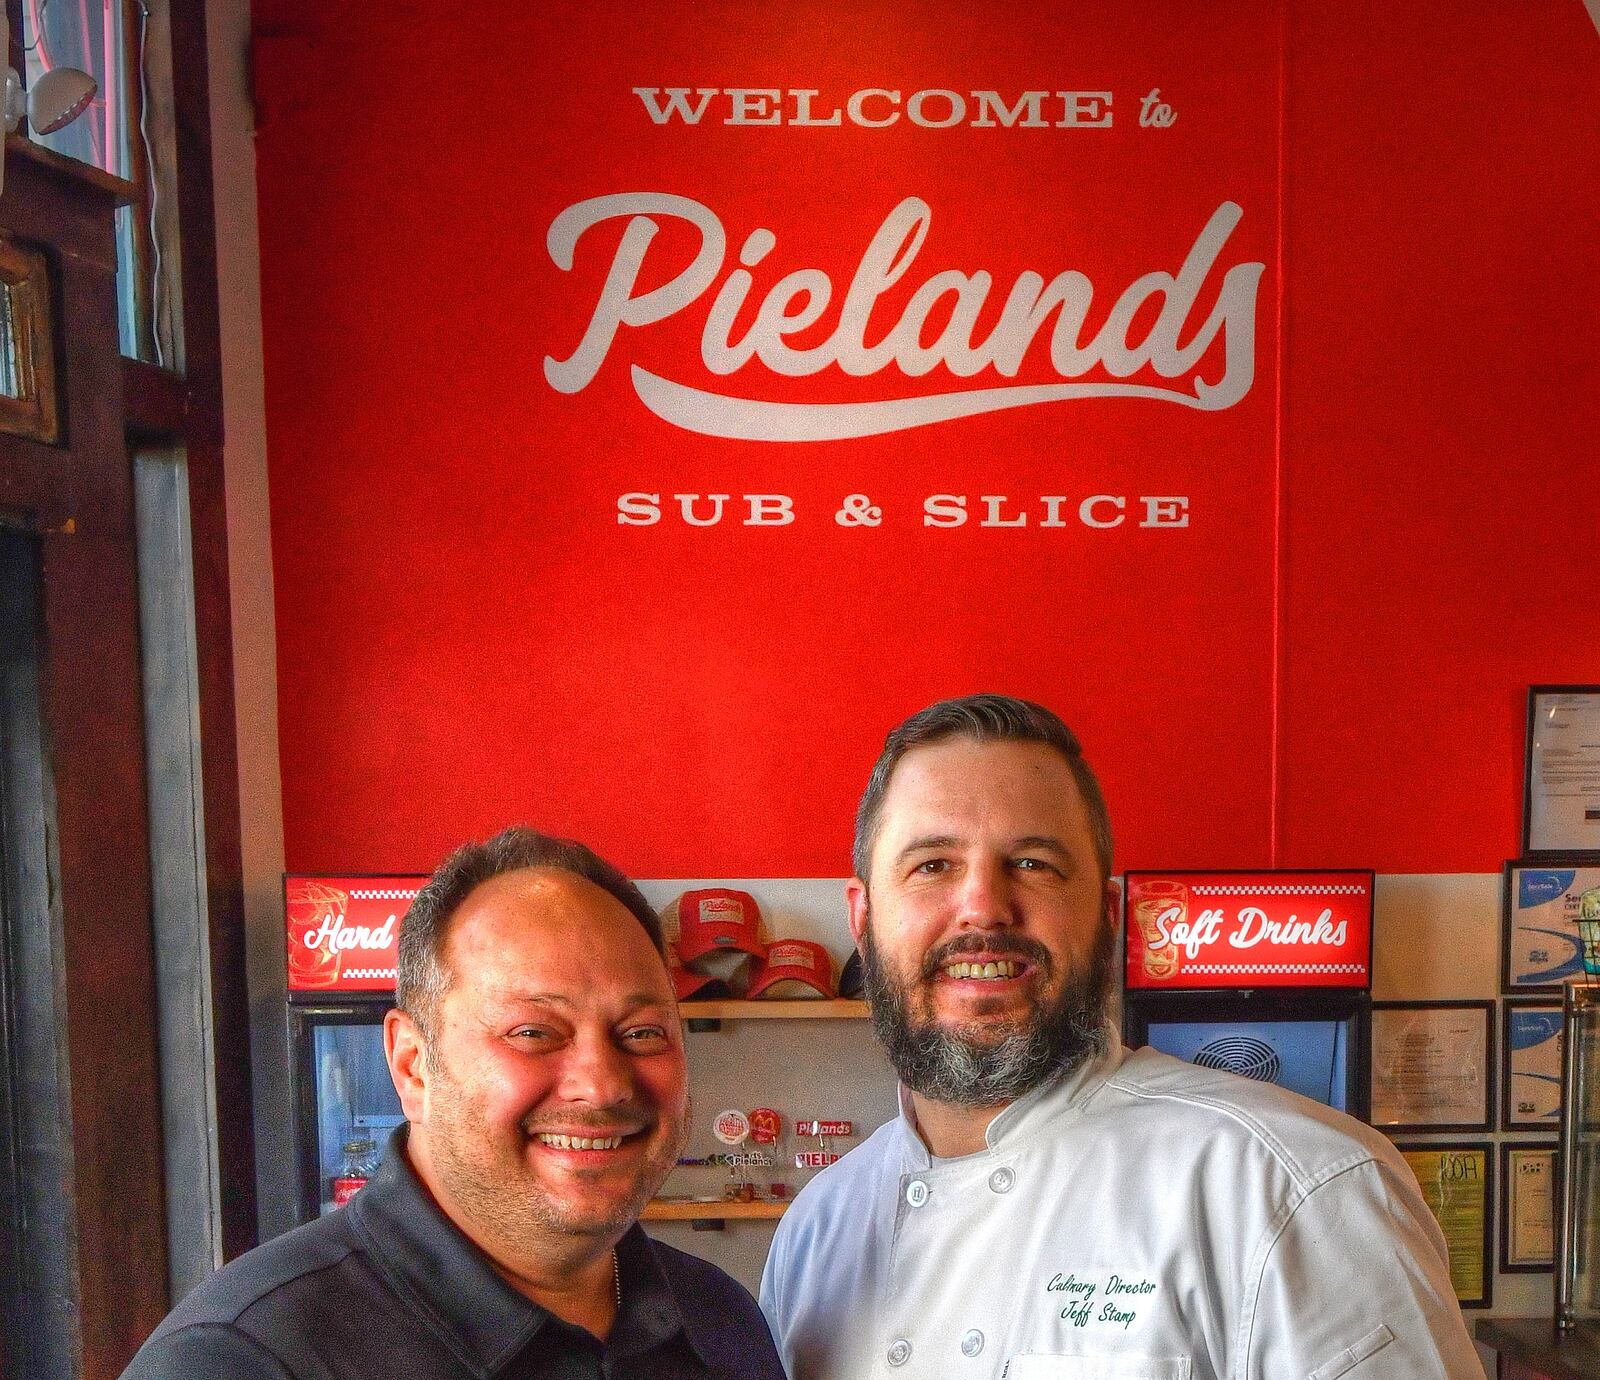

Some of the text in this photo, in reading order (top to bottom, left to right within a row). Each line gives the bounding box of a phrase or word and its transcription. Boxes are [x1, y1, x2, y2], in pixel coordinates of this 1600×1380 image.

[632, 87, 1178, 128] WELCOME to
[543, 191, 1267, 443] Pielands
[617, 492, 1190, 529] SUB & SLICE
[303, 913, 397, 955] Hard
[1148, 906, 1350, 960] Soft Drinks
[798, 1121, 851, 1134] Pilands
[1047, 1273, 1157, 1301] Culinary Director
[1060, 1301, 1137, 1330] Jeff Stamp
